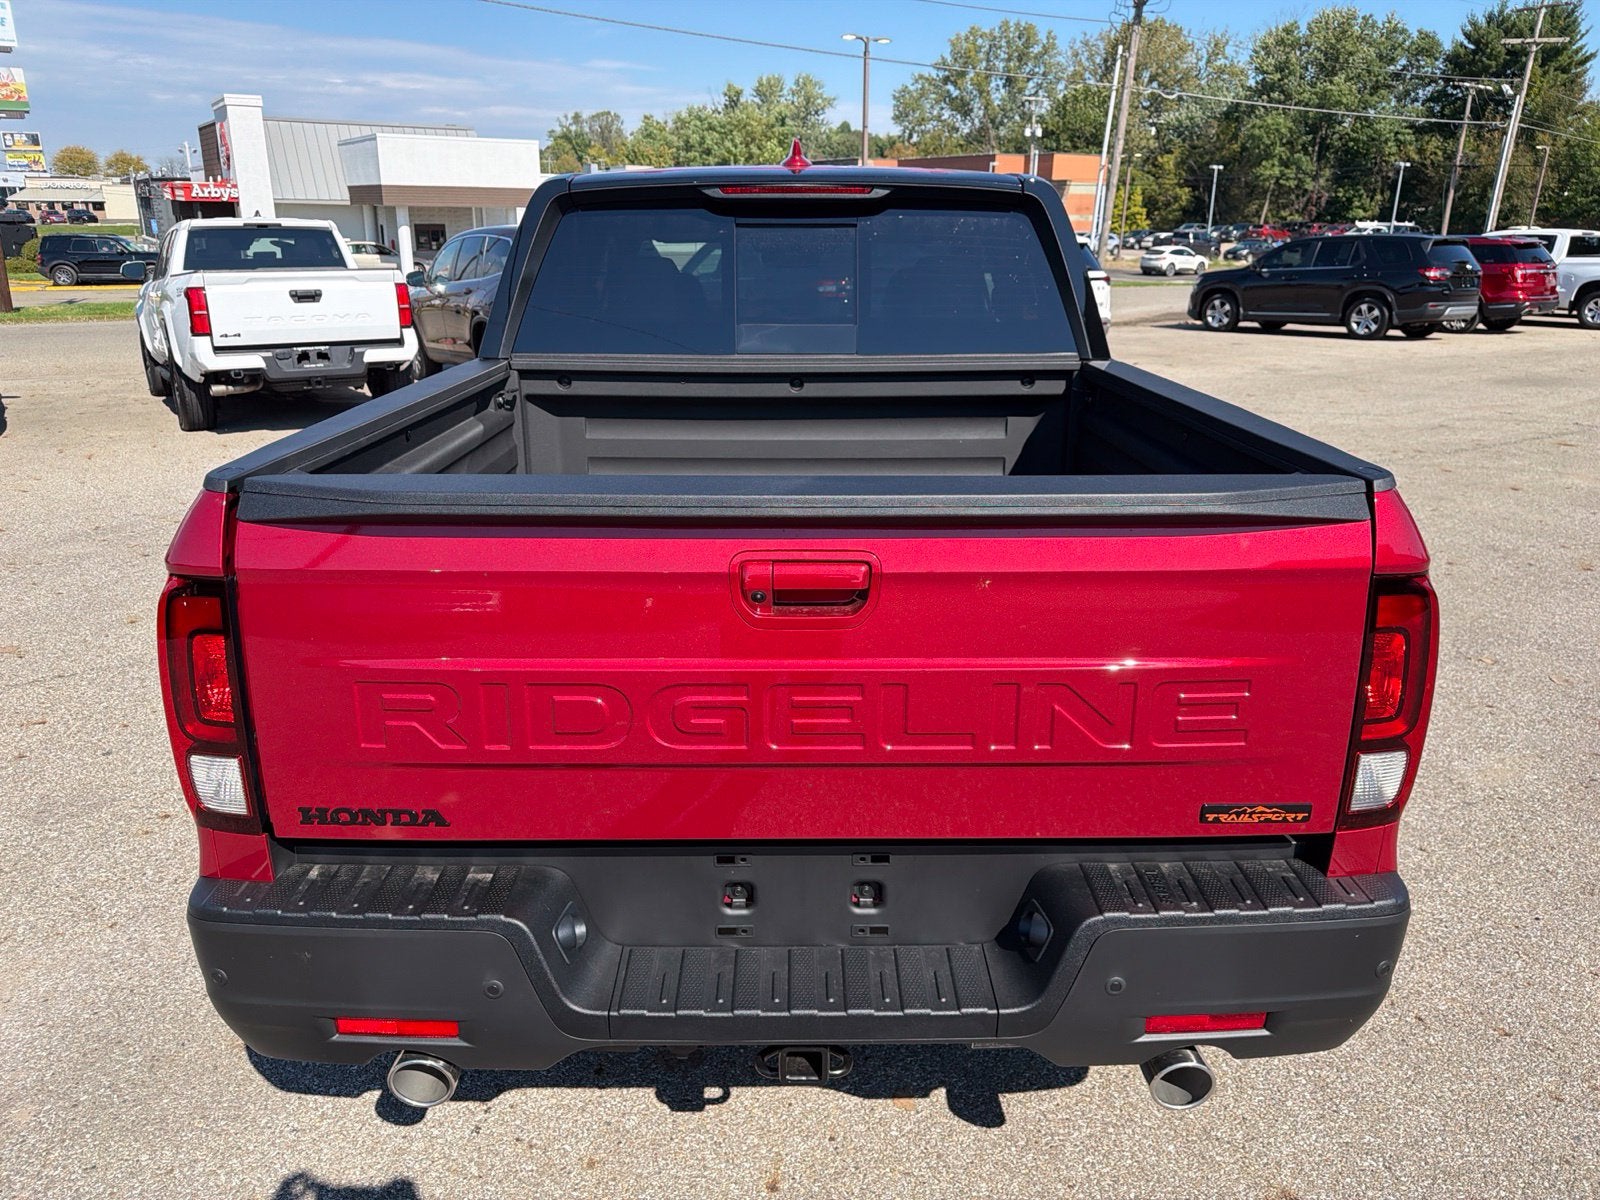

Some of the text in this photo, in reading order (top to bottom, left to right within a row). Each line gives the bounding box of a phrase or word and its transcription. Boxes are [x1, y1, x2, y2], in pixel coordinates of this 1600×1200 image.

[191, 183, 239, 201] Arby's
[243, 312, 372, 325] TACOMA
[353, 679, 1252, 751] RIDGELINE
[298, 807, 450, 827] HONDA
[1205, 813, 1309, 823] TRAILSPORT
